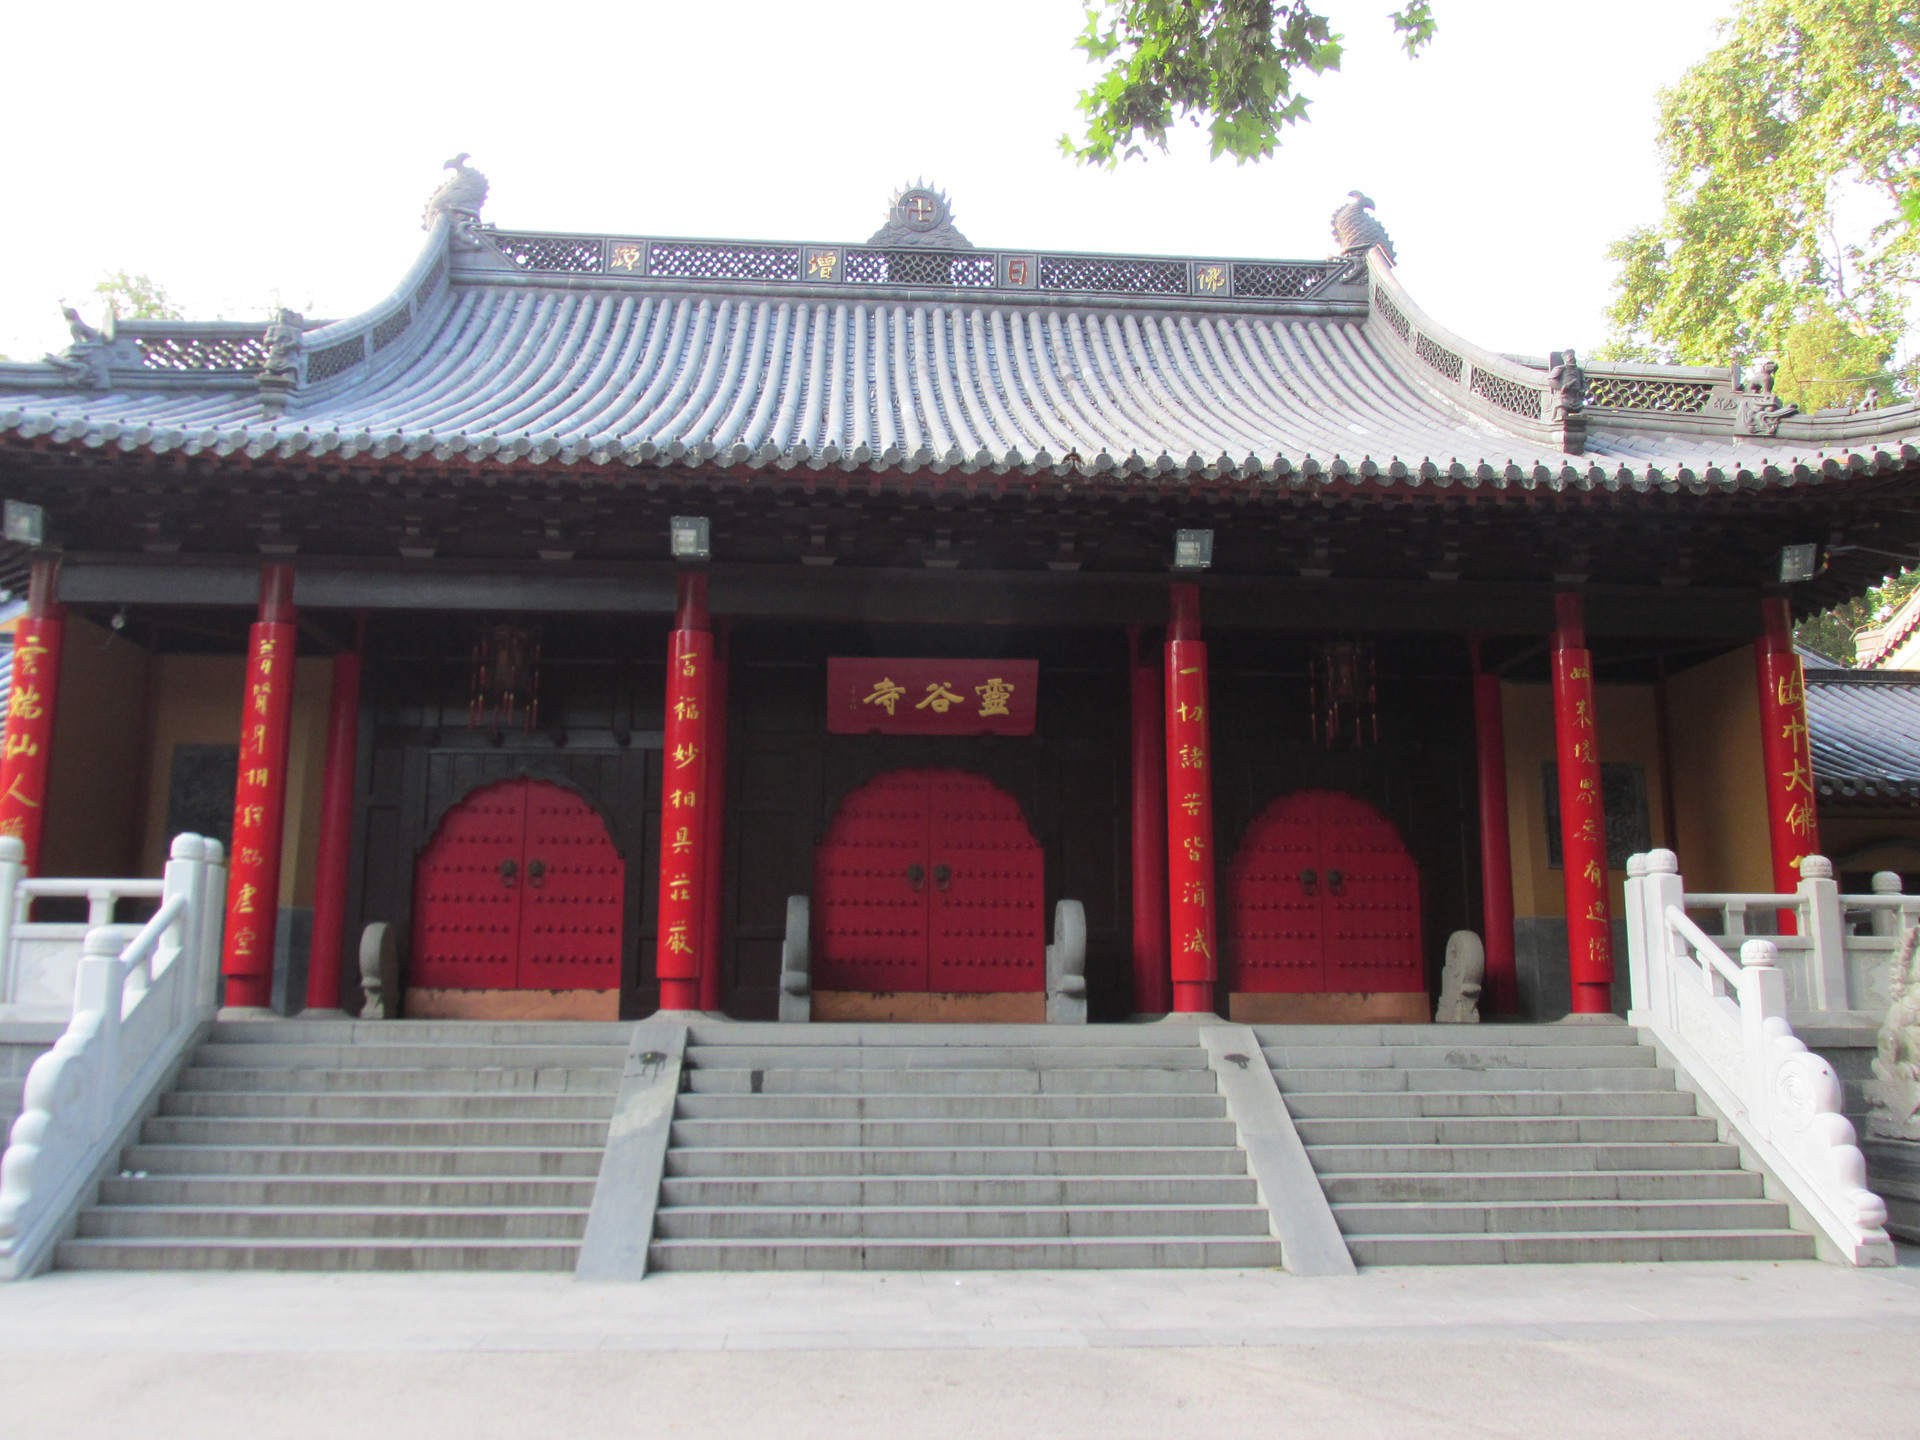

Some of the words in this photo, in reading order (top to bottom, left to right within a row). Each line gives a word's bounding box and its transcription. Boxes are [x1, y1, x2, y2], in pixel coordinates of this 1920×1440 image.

[1008, 259, 1028, 286] 日
[1197, 266, 1227, 292] 佛
[863, 677, 1015, 717] 靈谷寺
[1777, 670, 1817, 869] 海中大佛
